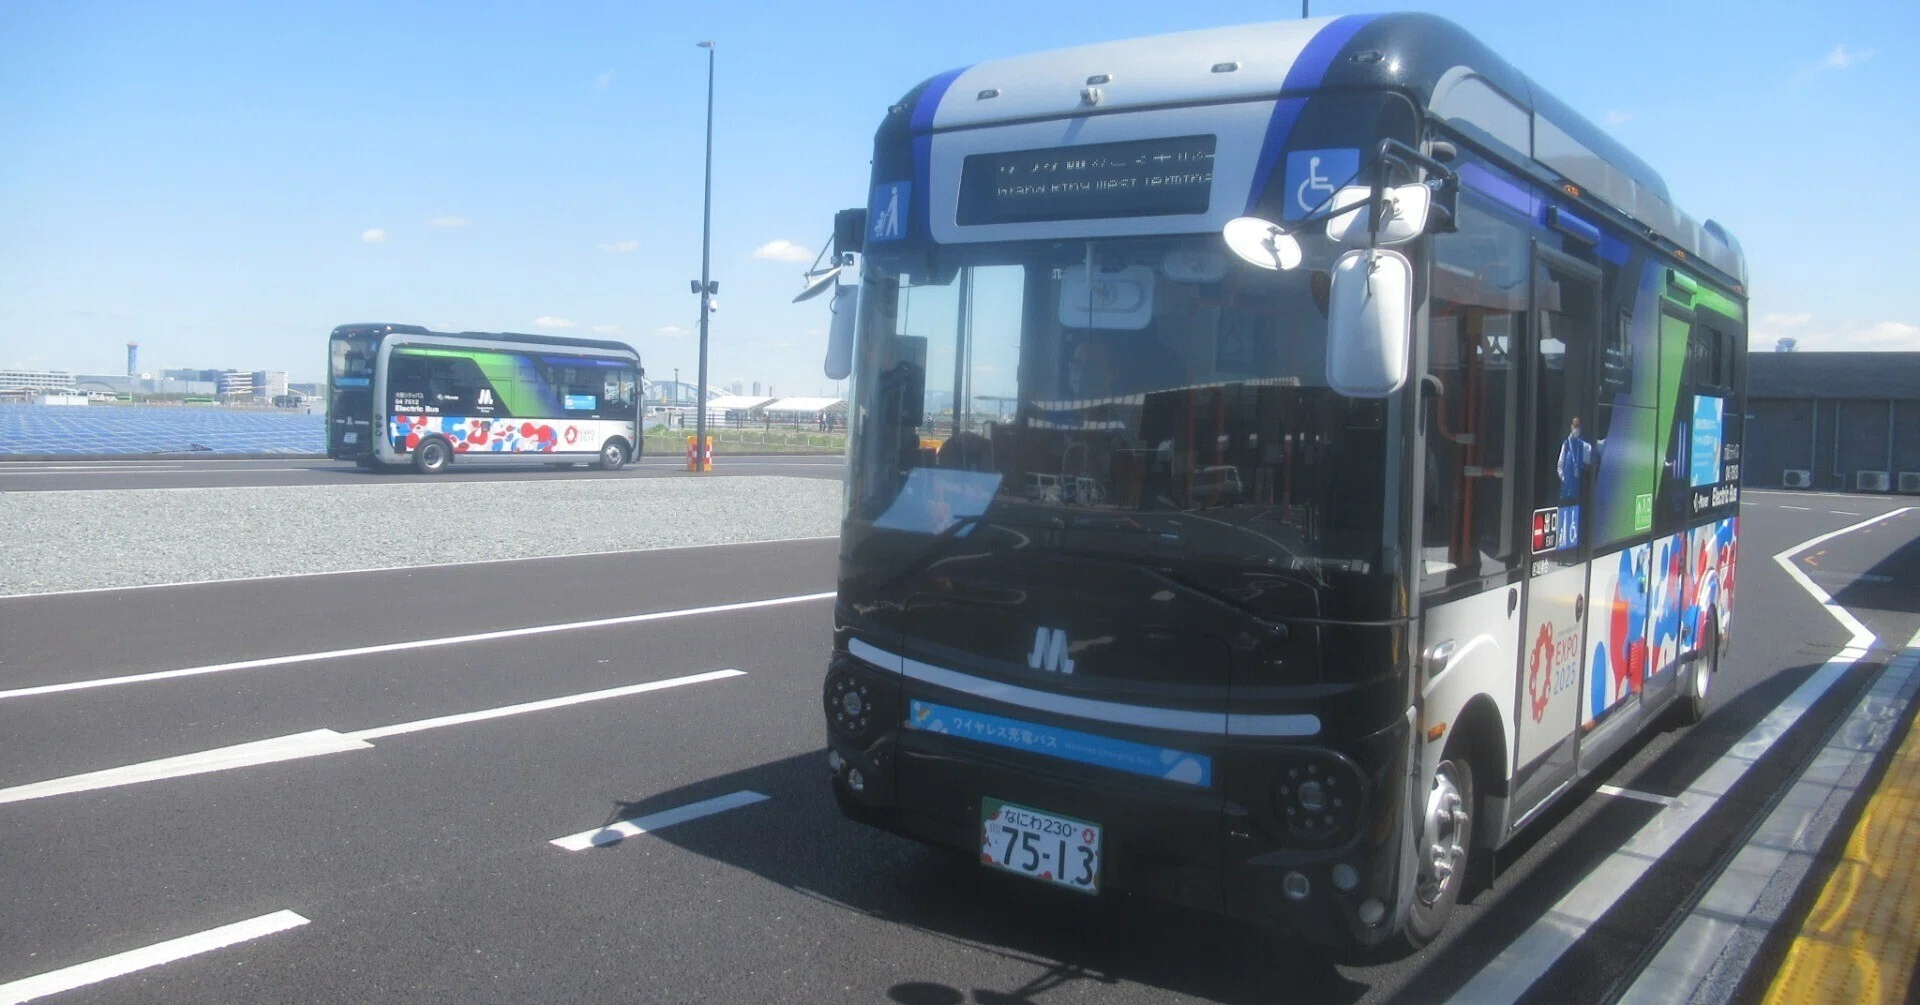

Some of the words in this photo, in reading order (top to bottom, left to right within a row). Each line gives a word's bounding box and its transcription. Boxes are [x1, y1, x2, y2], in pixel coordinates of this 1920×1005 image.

[395, 405, 424, 413] Electric
[425, 405, 440, 413] Bus
[1712, 485, 1729, 507] Electric
[1545, 534, 1555, 547] EXIT
[1556, 633, 1578, 666] EXPO
[1553, 661, 1576, 696] 2025
[953, 717, 1058, 749] ワイヤレス充電バス
[1001, 825, 1094, 885] 75-13
